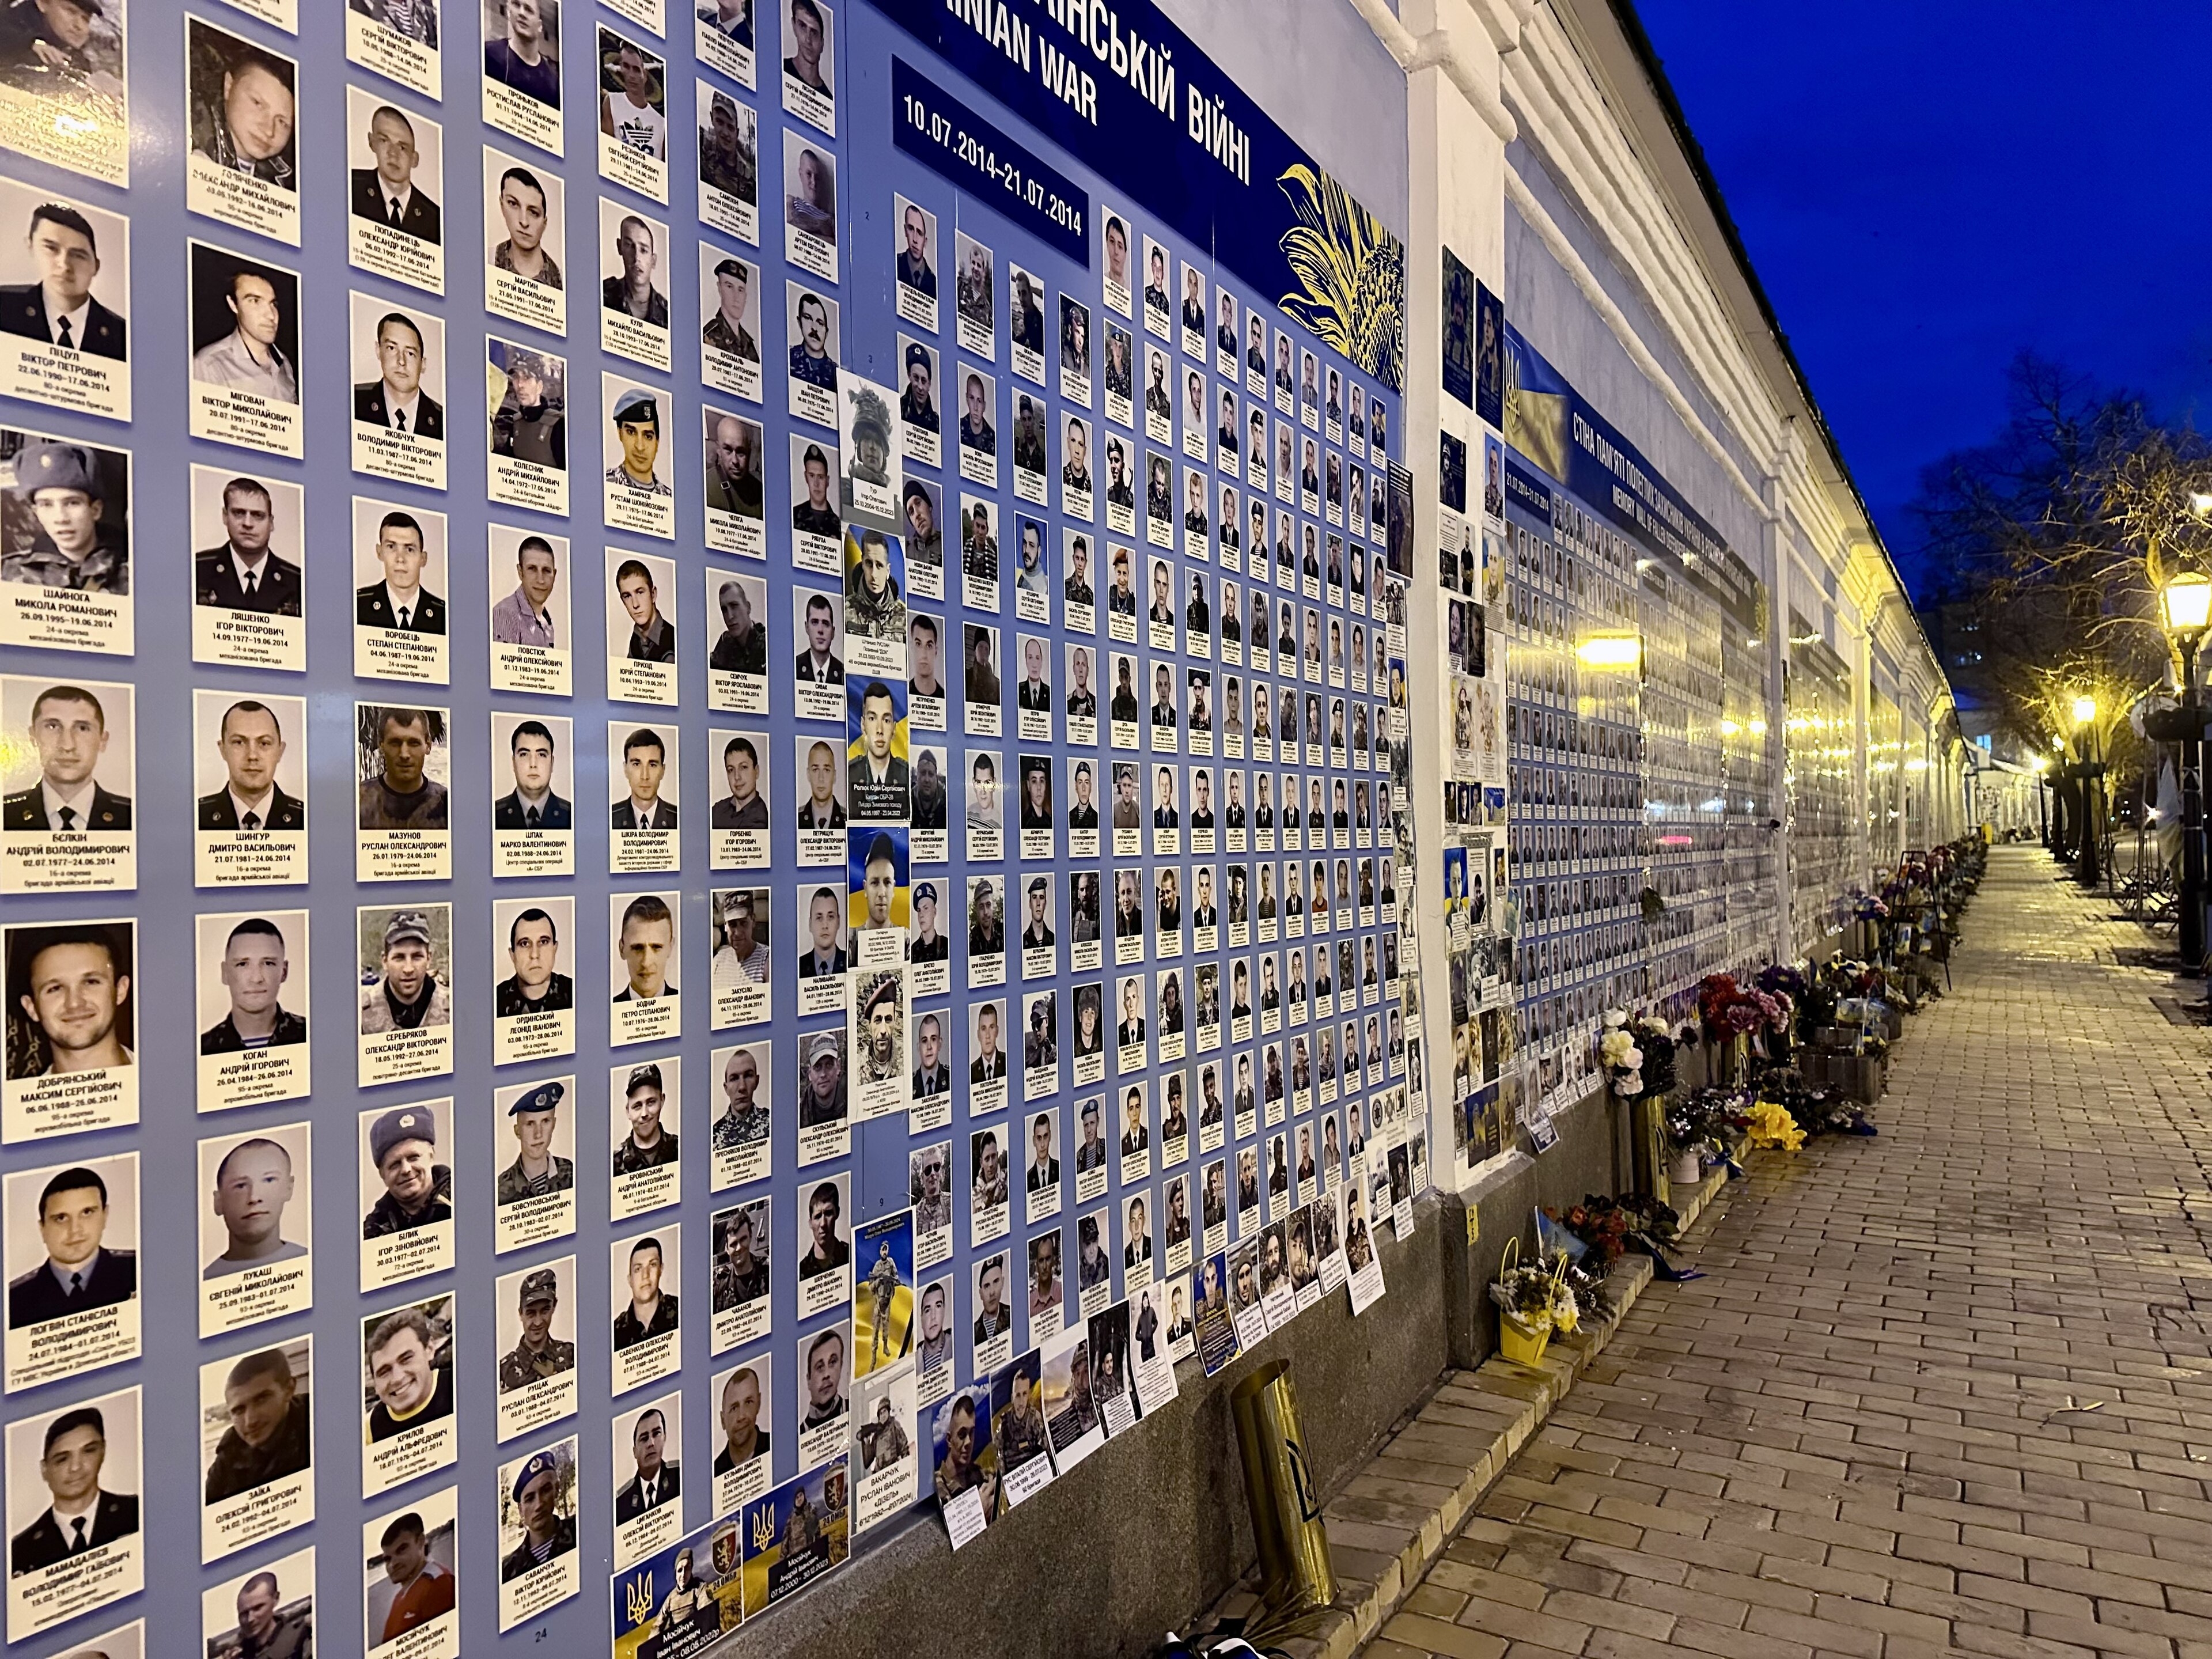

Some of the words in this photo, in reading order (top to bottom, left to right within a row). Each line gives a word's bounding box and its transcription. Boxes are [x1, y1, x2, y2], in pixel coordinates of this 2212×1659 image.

[1039, 35, 1097, 126] WAR
[1188, 83, 1249, 186] ВІЙНІ
[865, 211, 870, 221] 2
[374, 224, 421, 248] ПОПАДИНЕЦЬ
[358, 229, 399, 250] ОЛЕКСАНДР
[400, 244, 435, 263] ЮРІЙОВИЧ
[514, 275, 538, 290] МАРТИН
[496, 279, 517, 292] СЕРГІЙ
[517, 286, 555, 306] ВАСИЛЬОВИЧ
[868, 354, 873, 363] 3
[230, 391, 265, 407] МІГОВАН
[202, 395, 231, 409] ВІКТОР
[232, 403, 291, 424] МИКОЛАЙОВИЧ
[384, 429, 415, 444] ЯКОБЧУК
[1573, 411, 1595, 457] СТІНА
[357, 432, 400, 449] ВОЛОДИМИР
[400, 442, 441, 459] ВІКТОРОВИЧ
[513, 460, 544, 474] КОЛЕСНИК
[497, 465, 520, 478] АНДРІЙ
[520, 471, 559, 487] МИХАЙЛОВИЧ
[1613, 484, 1635, 518] MEMORY
[230, 611, 270, 624] ЛЯШЕНКО
[215, 621, 234, 631] ІГОР
[235, 623, 284, 637] ВІКТОРОВИЧ
[384, 630, 420, 642] ВОРОБЕЦЬ
[366, 638, 393, 649] СТЕПАН
[394, 641, 437, 653] СТЕПАНОВИЧ
[517, 646, 546, 657] ПОВСТЮК
[500, 653, 522, 664] АНДРІЙ
[522, 656, 562, 668] ОЛЕКСІЙОВИЧ
[633, 660, 653, 671] ПРИХІД
[619, 667, 634, 676] ЮРІЙ
[633, 669, 666, 679] СТЕПАНОВИЧ
[869, 784, 881, 793] Юрій
[881, 785, 906, 793] Сергійович
[235, 832, 270, 841] ШИНГУР
[388, 831, 421, 840] МАЗУНОВ
[525, 831, 543, 839] ШПАК
[638, 831, 669, 839] ВОЛОДИМИР
[207, 843, 243, 854] ДМИТРО
[244, 843, 296, 852] ВАСИЛЬОВИЧ
[361, 842, 389, 850] РУСЛАН
[389, 841, 446, 851] ОЛЕКСАНДРОВИЧ
[521, 840, 567, 848] ВАЛЕНТИНОВИЧ
[623, 839, 668, 847] ВОЛОДИМИРОВИЧ
[635, 998, 657, 1008] БОДНАР
[516, 1010, 555, 1024] ОРДИНСЬКИЙ
[621, 1010, 638, 1018] ПЕТРО
[638, 1005, 671, 1017] СТЕПАНОВИЧ
[385, 1029, 427, 1041] СЕРЕБРЯКОВ
[509, 1024, 532, 1035] ЛЕОНІД
[532, 1021, 560, 1031] ІВАНОВИЧ
[365, 1042, 406, 1055] ОЛЕКСАНДР
[406, 1036, 447, 1049] ВІКТОРОВИЧ
[242, 1050, 267, 1060] КОГАН
[219, 1061, 250, 1075] АНДРІЙ
[251, 1058, 289, 1071] ІГОРОВИЧ
[879, 1197, 884, 1207] 9
[499, 1211, 520, 1225] СЕРГІЙ
[520, 1199, 571, 1219] ВОЛОДИМИРОВИЧ
[398, 1229, 419, 1241] БІЛИК
[377, 1245, 393, 1256] ІГОР
[870, 1465, 899, 1487] ВАКАРЧУК
[1012, 1466, 1026, 1480] ВІТАЛІЙ
[861, 1486, 882, 1504] РУСЛАН
[884, 1471, 910, 1491] ІВАНОВИЧ
[823, 1516, 831, 1527] 24
[779, 1567, 798, 1584] Андрій
[798, 1555, 819, 1573] Іванович
[713, 1581, 721, 1591] 24
[535, 1627, 547, 1643] 24
[662, 1619, 695, 1643] Мосійчук
[657, 1644, 672, 1659] Іван
[672, 1627, 701, 1650] Іванович
